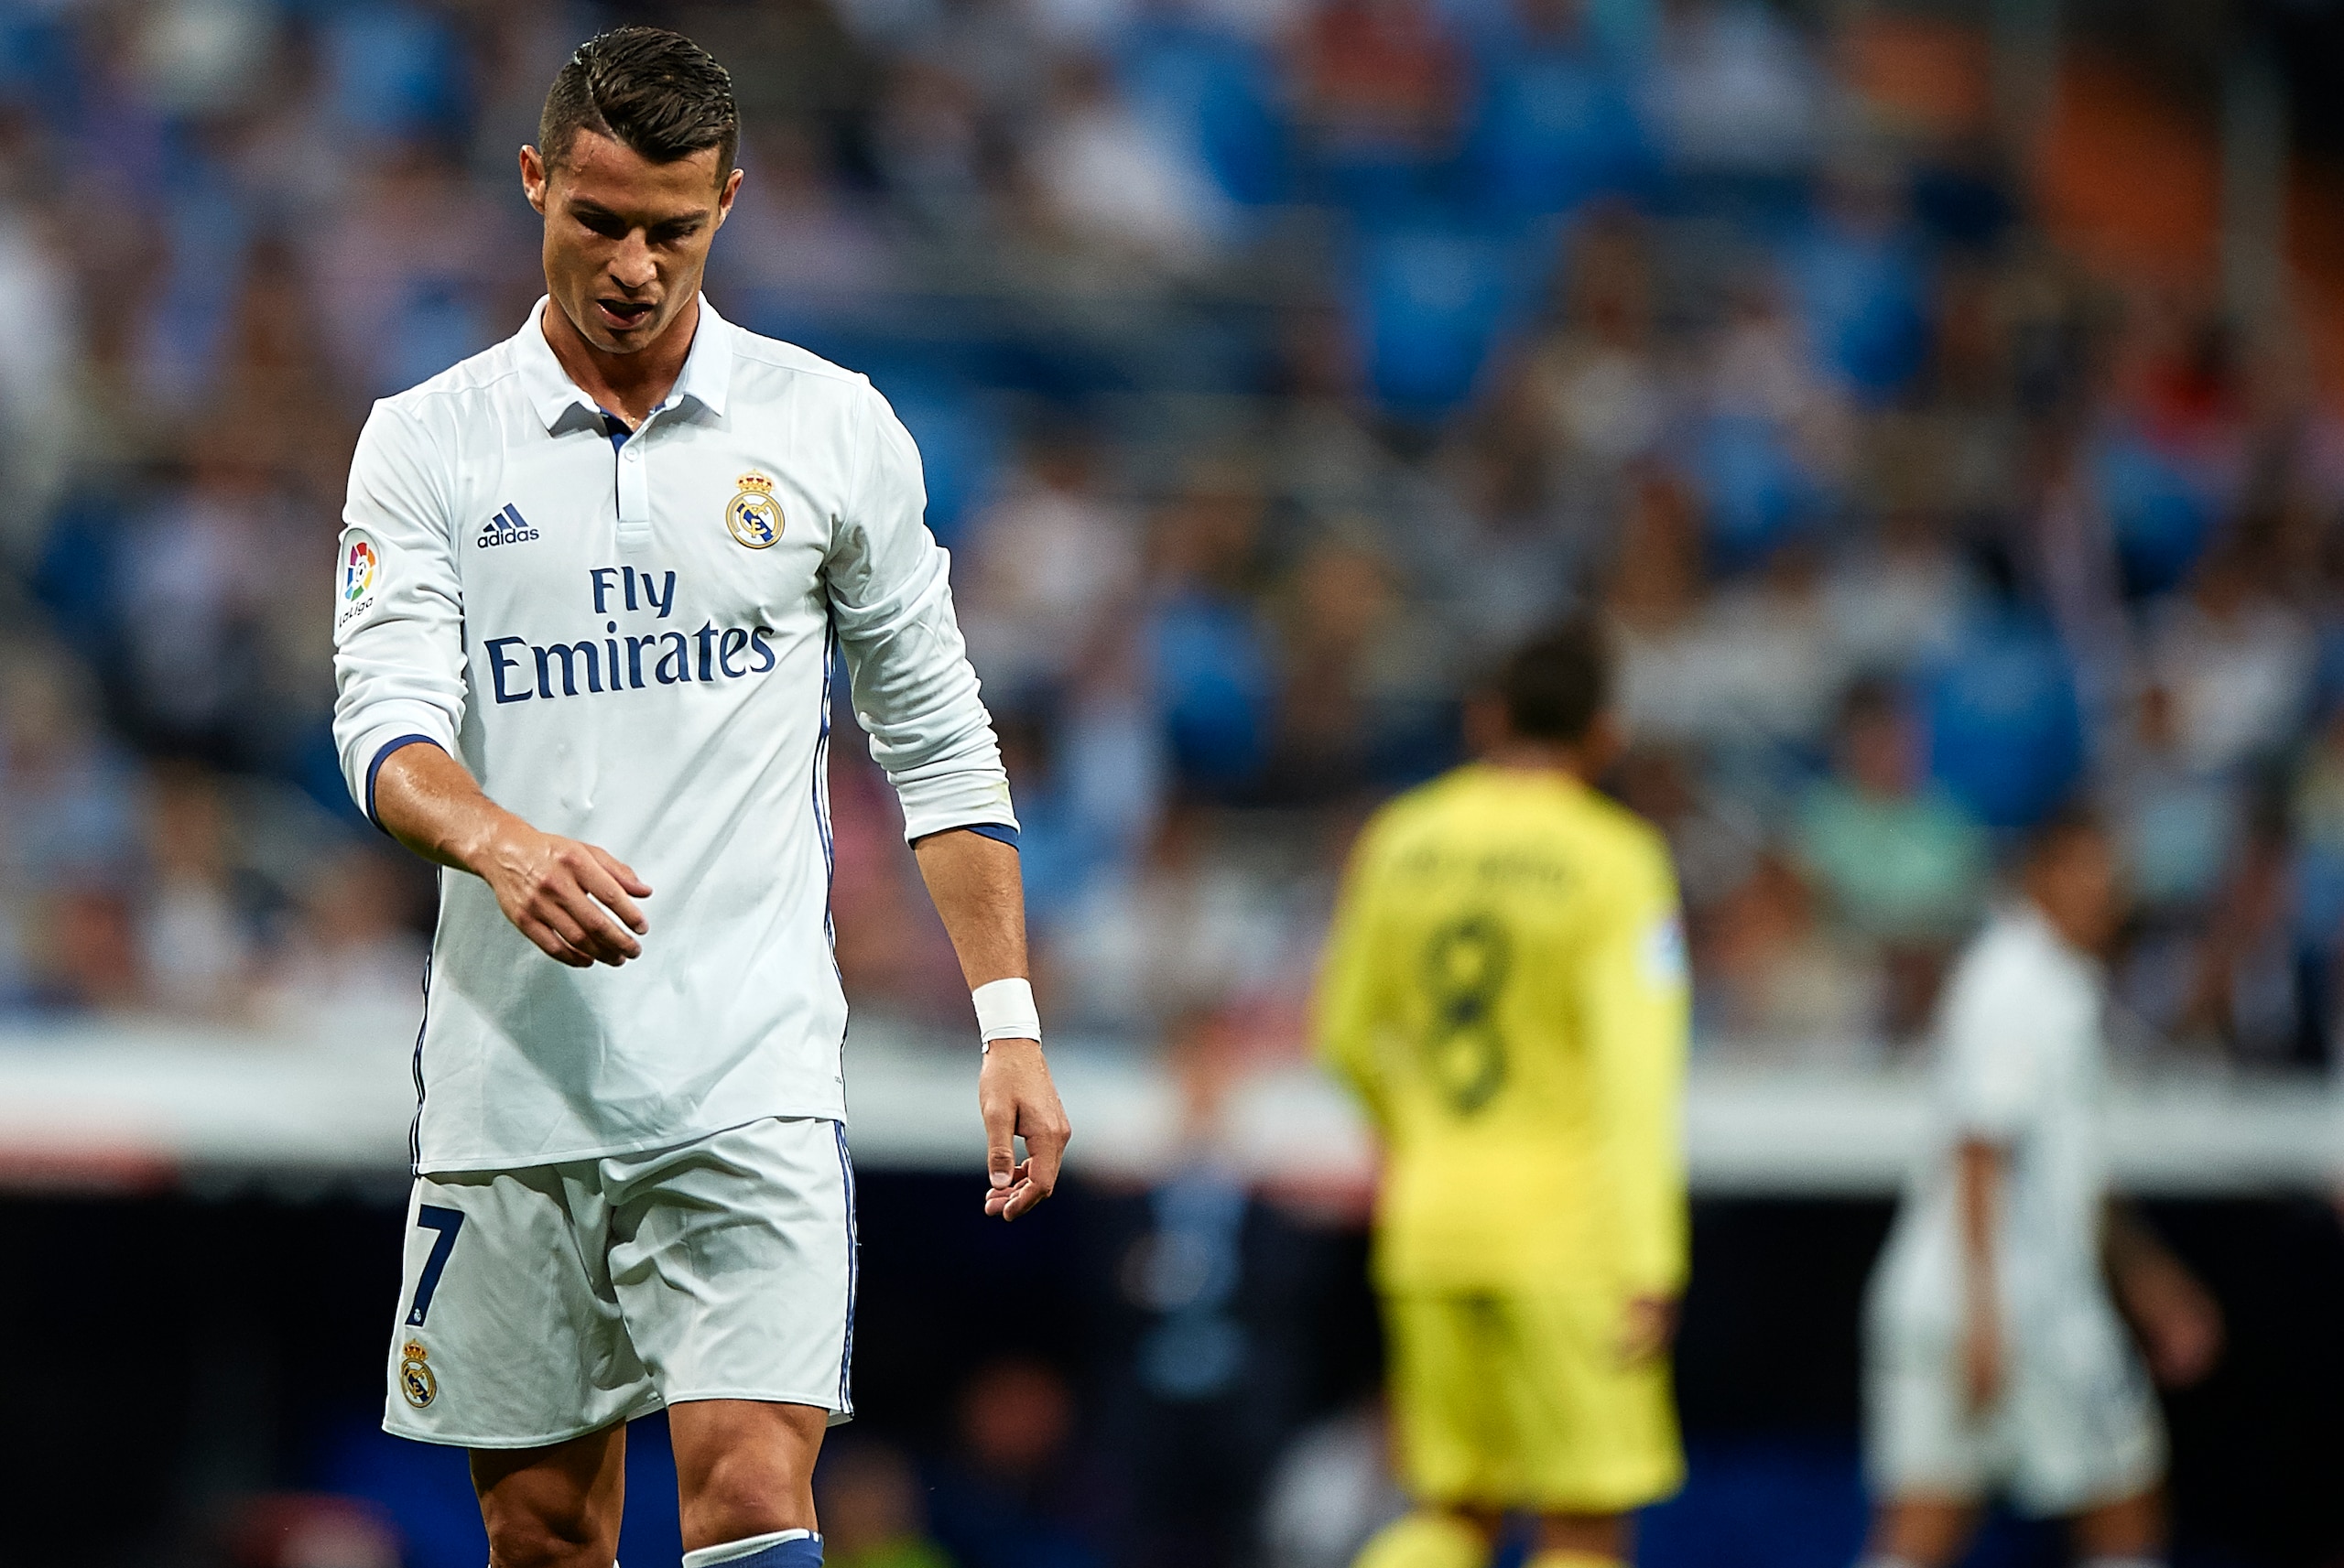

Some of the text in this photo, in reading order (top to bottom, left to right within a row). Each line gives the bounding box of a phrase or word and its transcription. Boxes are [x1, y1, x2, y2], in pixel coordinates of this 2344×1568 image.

[477, 528, 540, 549] adidas
[590, 566, 677, 619] Fly
[483, 619, 776, 705] Emirates
[1417, 904, 1516, 1119] 8
[405, 1204, 466, 1327] 7
